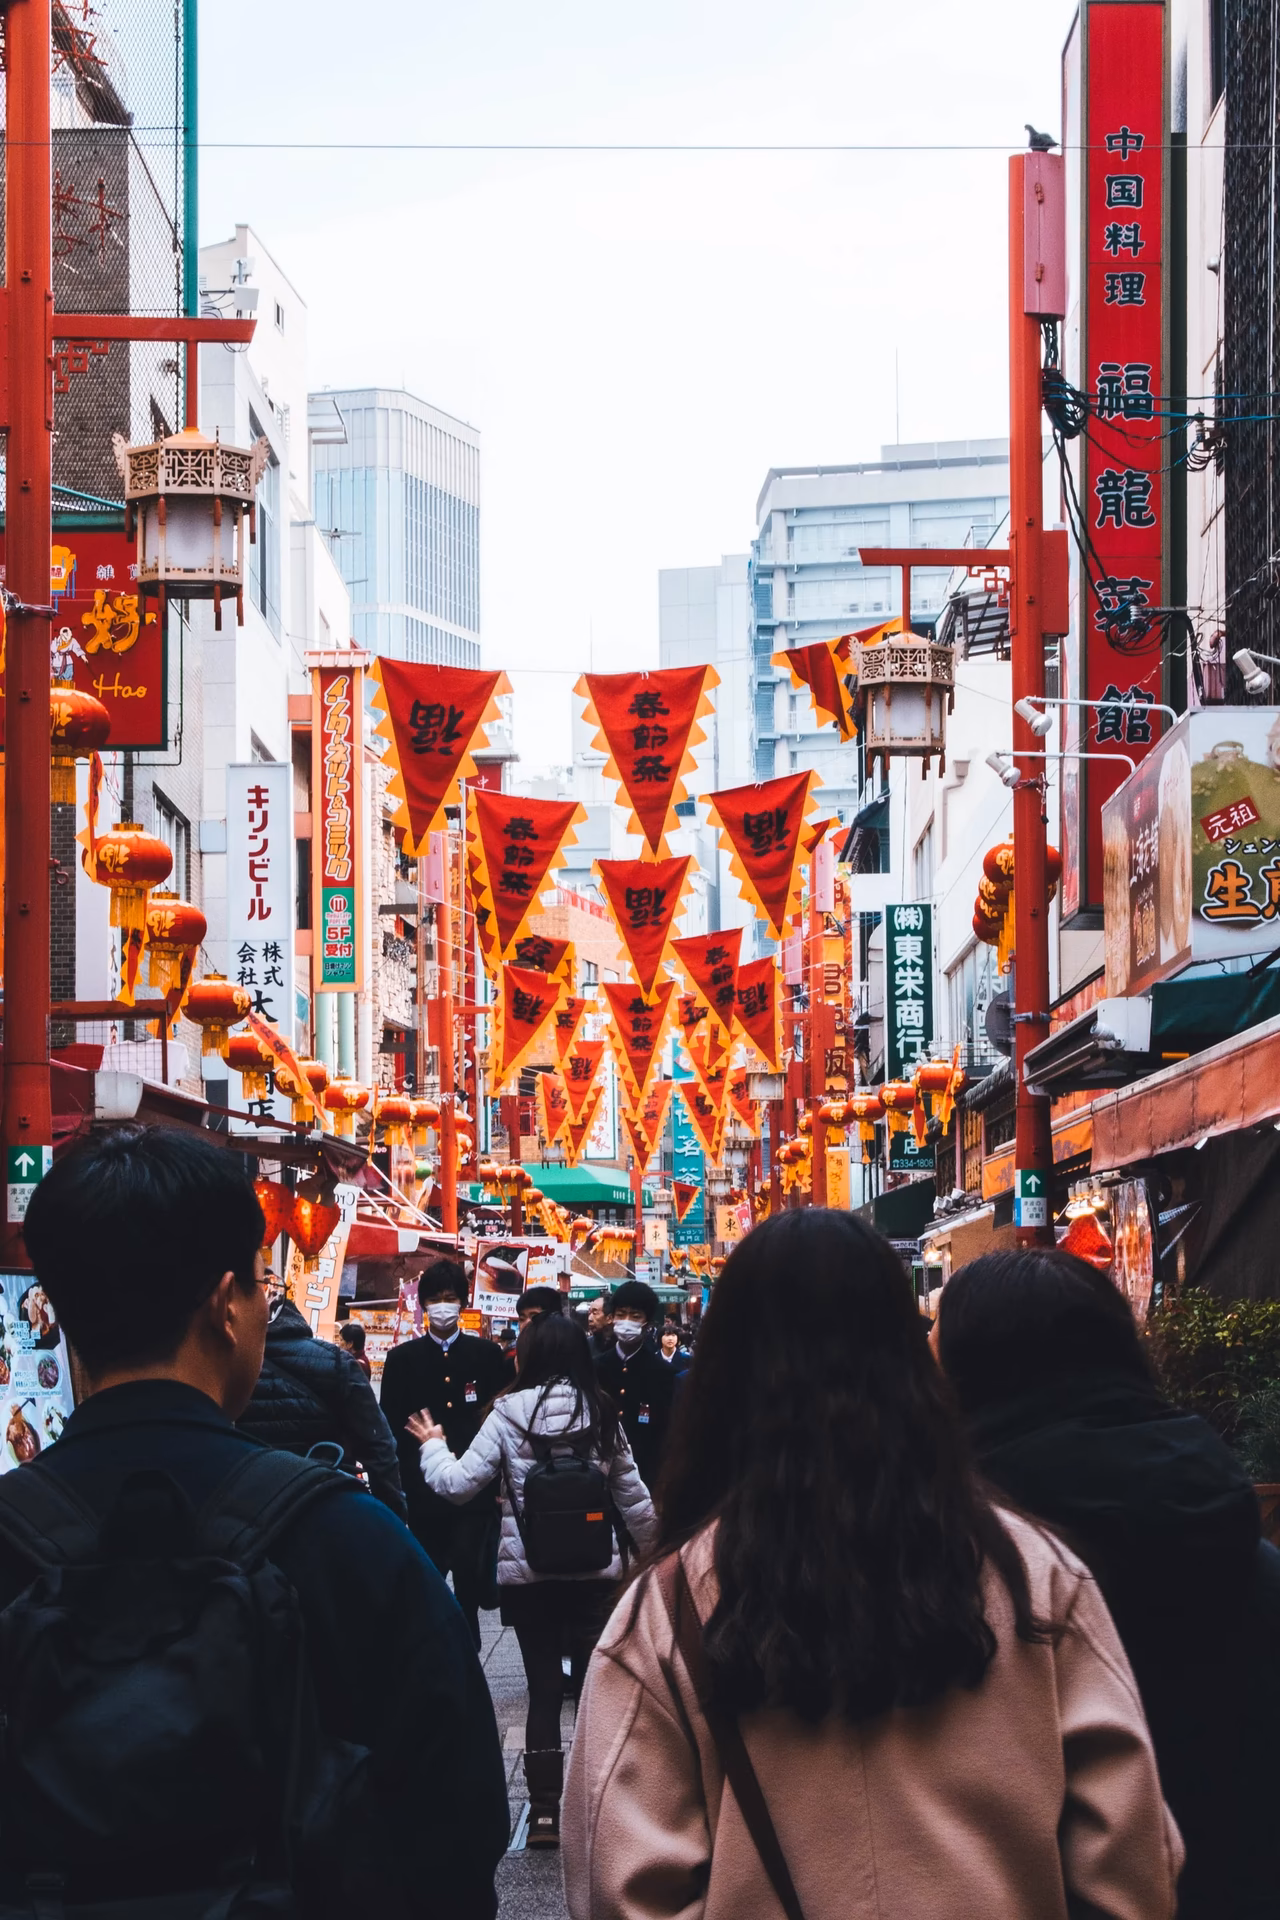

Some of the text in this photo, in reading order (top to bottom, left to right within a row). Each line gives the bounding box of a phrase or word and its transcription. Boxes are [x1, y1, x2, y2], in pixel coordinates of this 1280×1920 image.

[1103, 126, 1146, 306] 中国料理
[82, 589, 156, 654] 好
[93, 672, 147, 698] Hao
[325, 676, 351, 880] インターネット&コミック
[1208, 803, 1256, 839] 元祖
[247, 784, 272, 922] キリンビール
[1224, 838, 1280, 854] シェン
[325, 943, 352, 957] 受付
[327, 926, 350, 940] 5F
